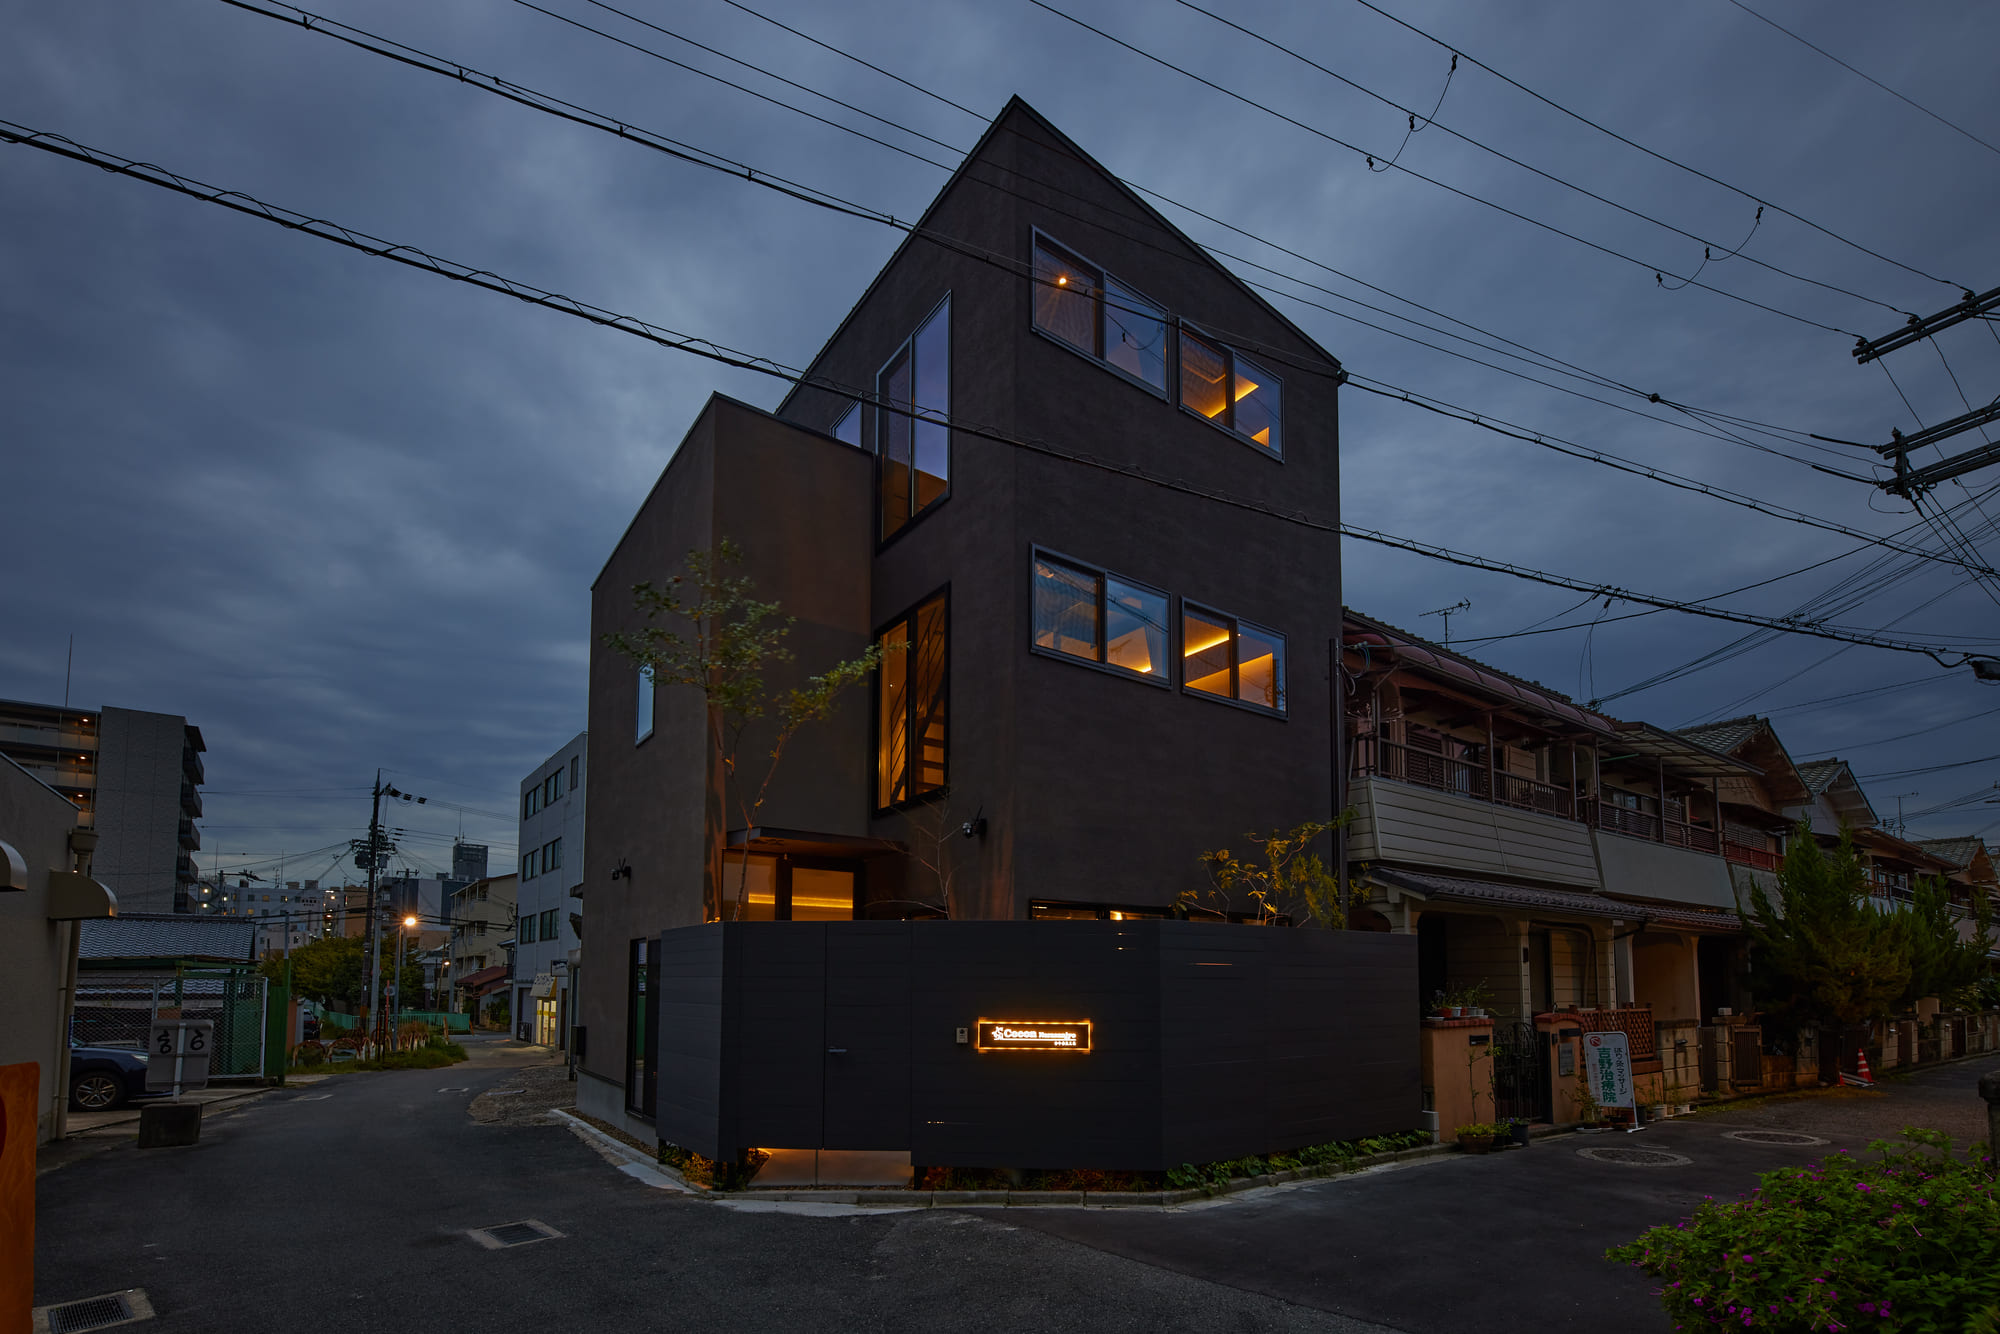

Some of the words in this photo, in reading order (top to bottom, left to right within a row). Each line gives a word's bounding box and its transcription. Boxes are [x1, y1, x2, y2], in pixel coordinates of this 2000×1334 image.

[1597, 1047, 1617, 1103] 吉野治療院
